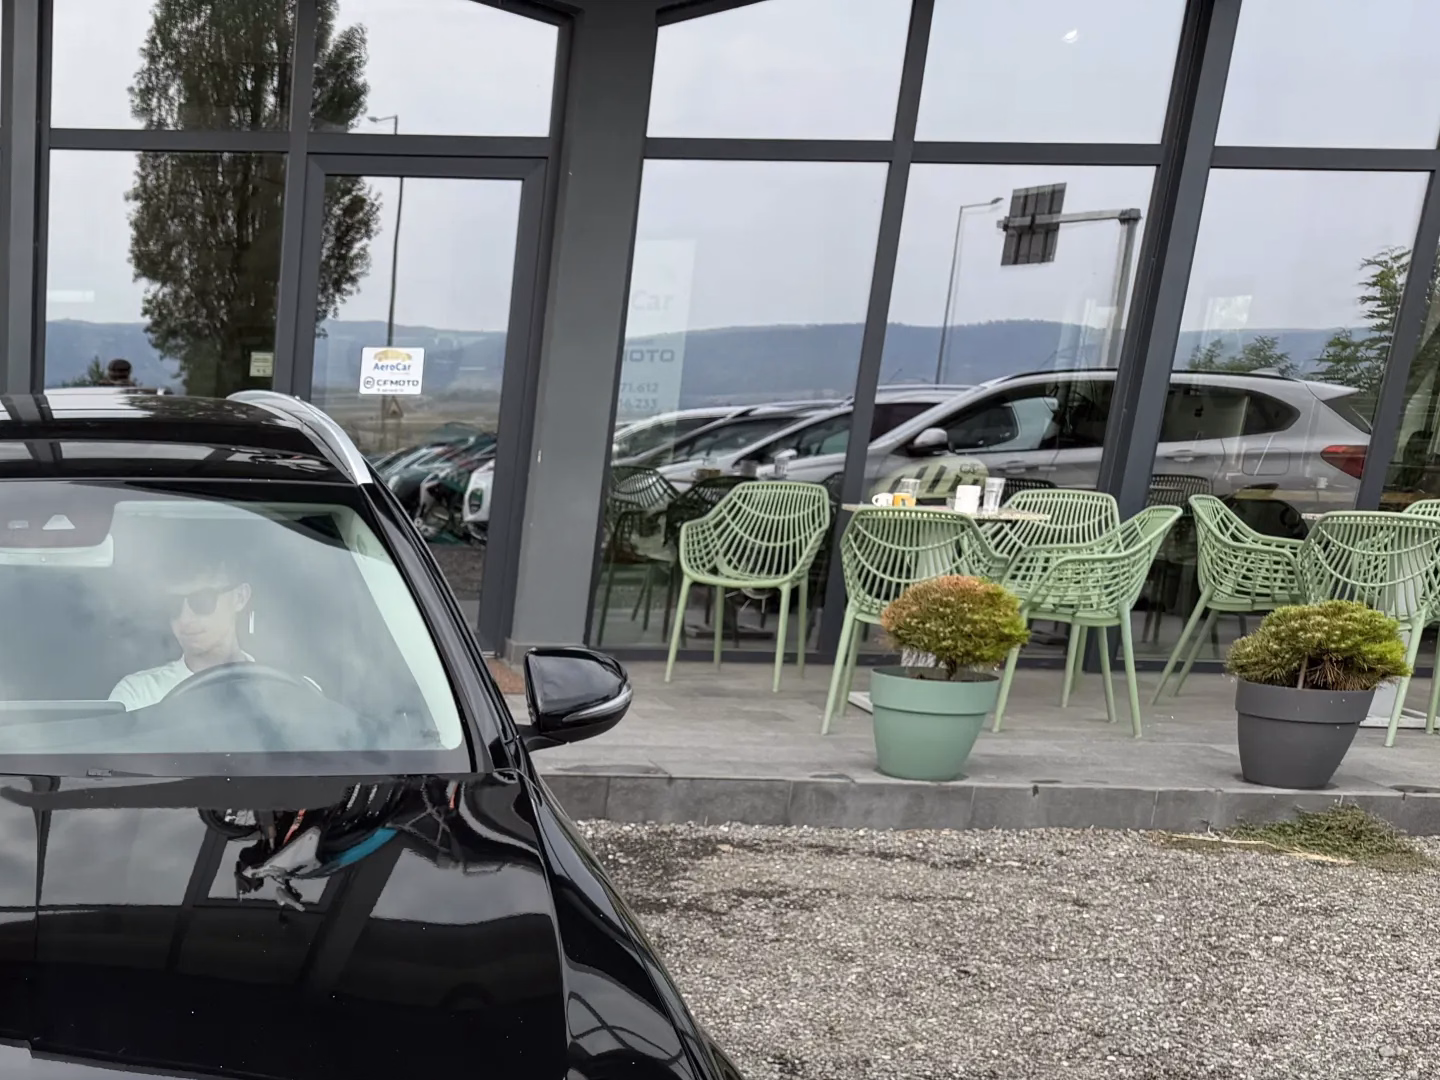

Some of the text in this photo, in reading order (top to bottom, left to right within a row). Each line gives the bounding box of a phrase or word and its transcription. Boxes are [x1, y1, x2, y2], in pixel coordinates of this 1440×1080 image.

[623, 349, 675, 363] OTO
[373, 362, 411, 371] AeroCar
[376, 379, 419, 387] CFMOTO
